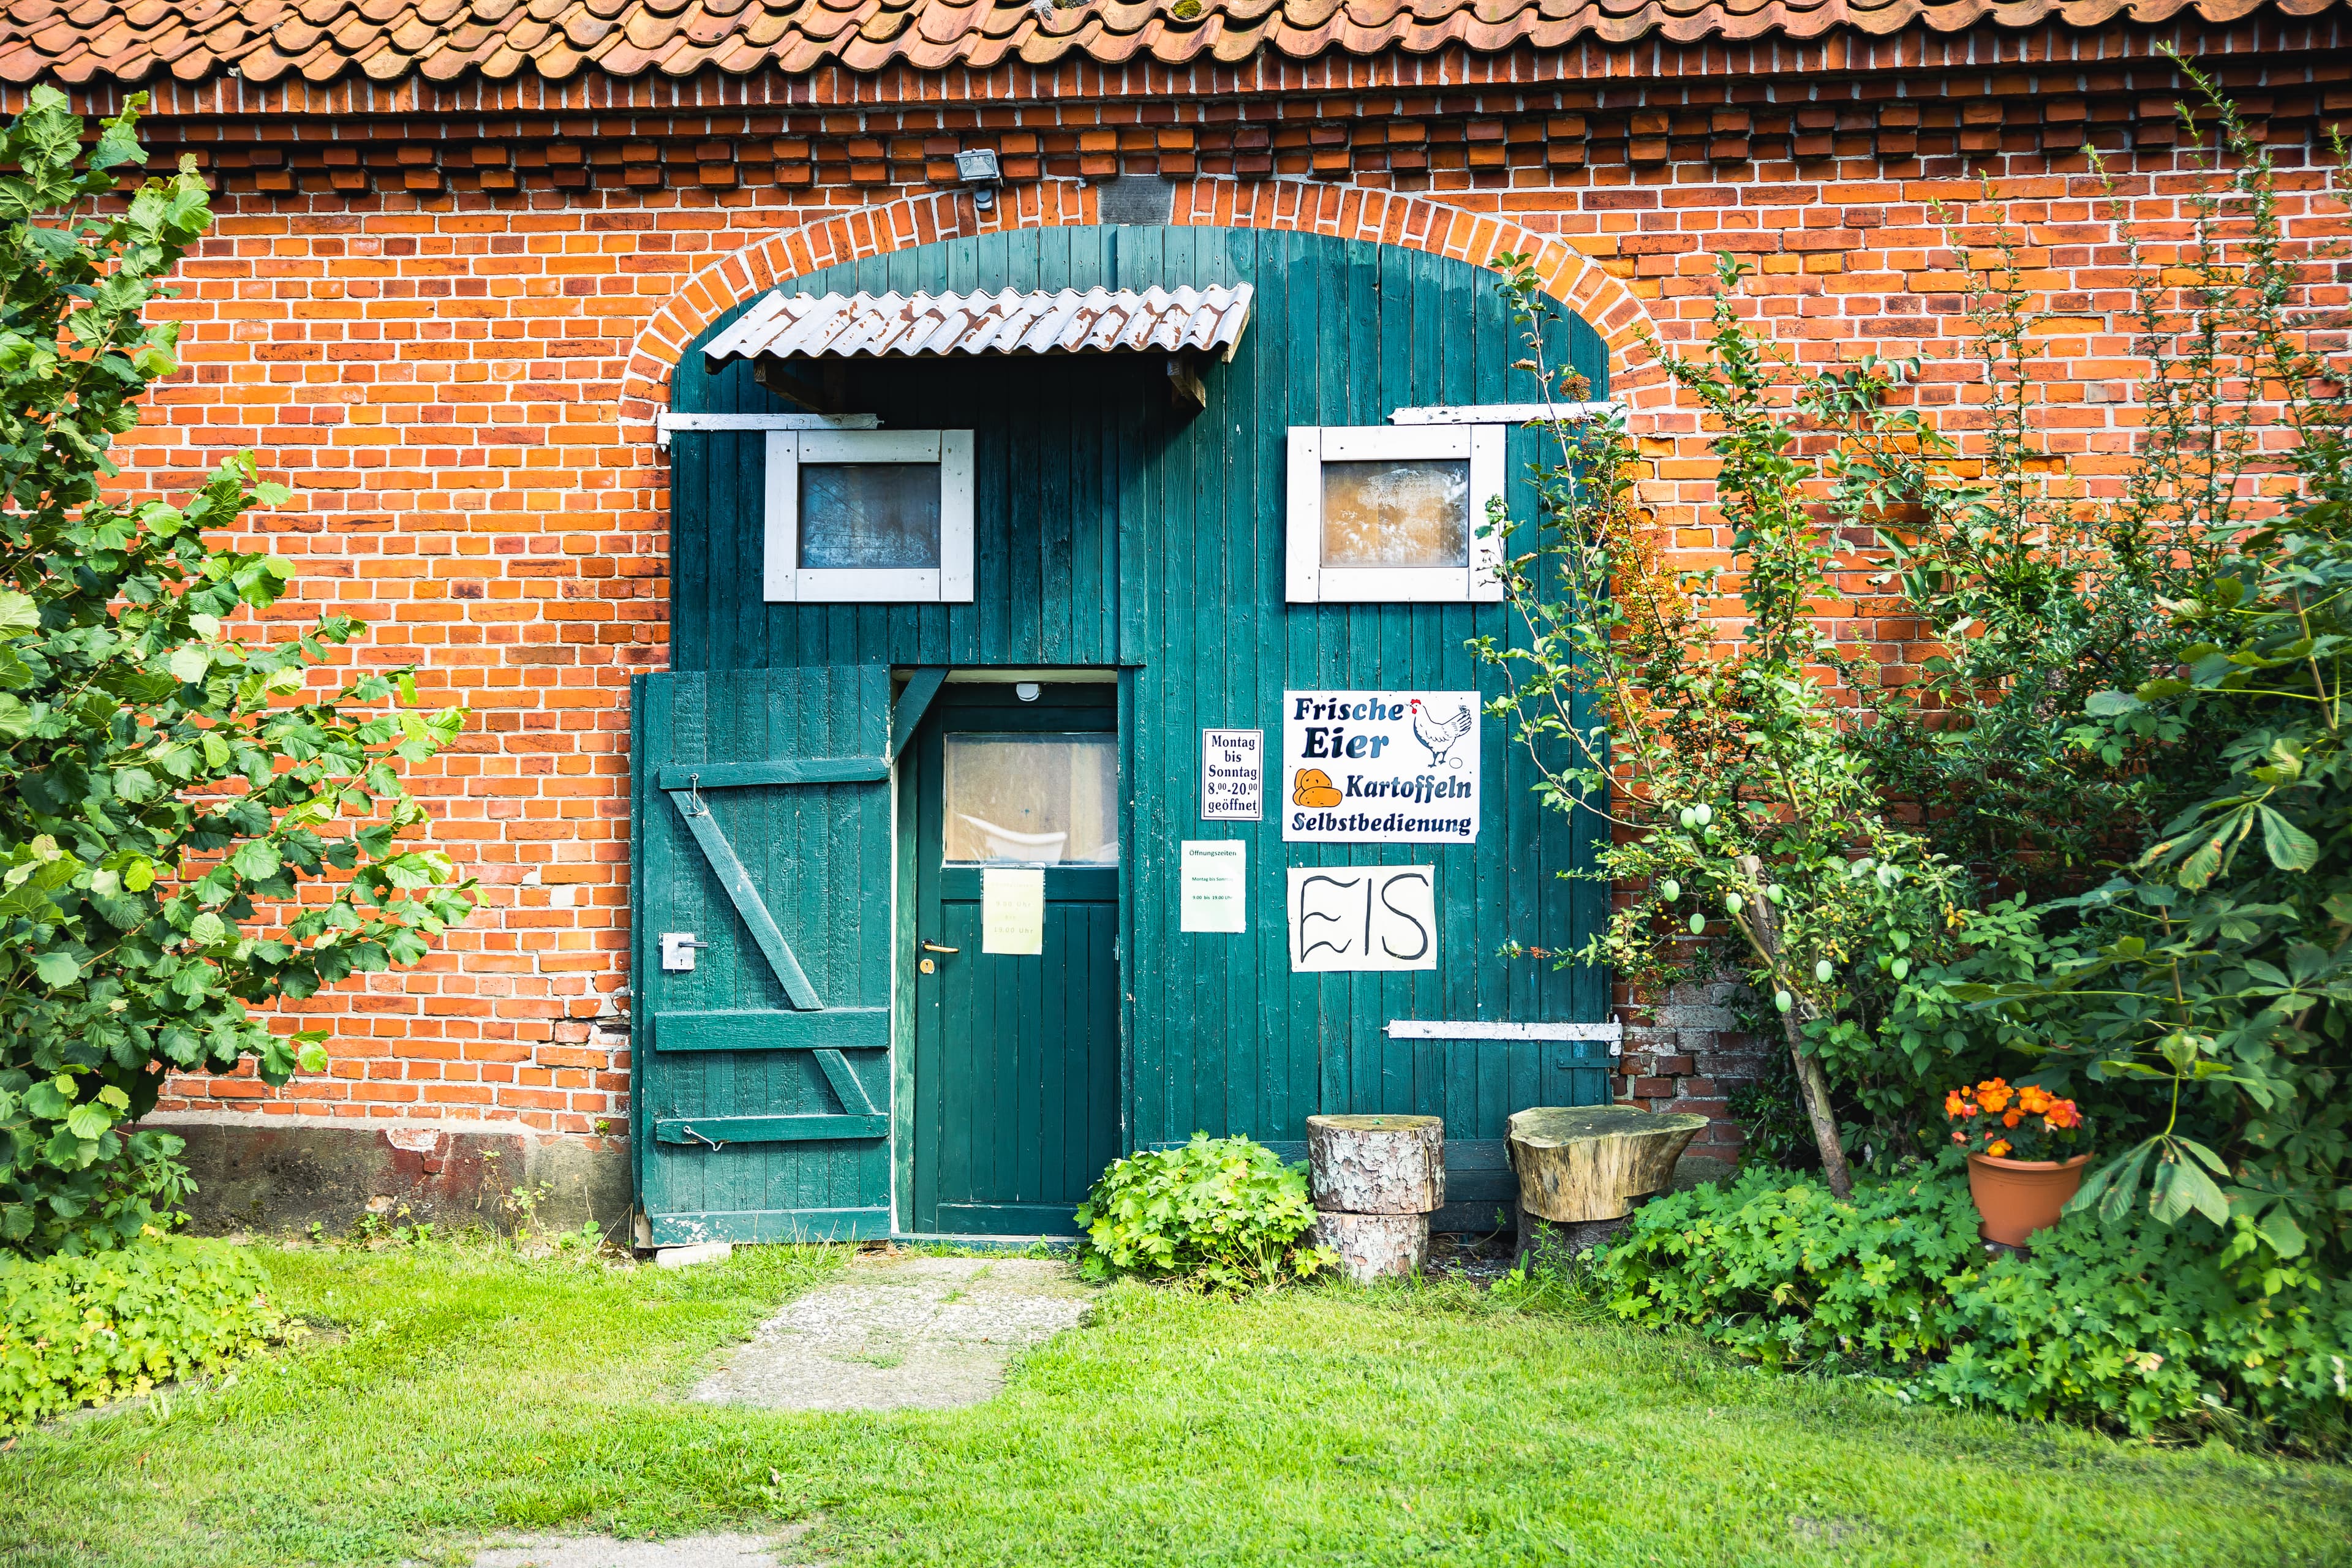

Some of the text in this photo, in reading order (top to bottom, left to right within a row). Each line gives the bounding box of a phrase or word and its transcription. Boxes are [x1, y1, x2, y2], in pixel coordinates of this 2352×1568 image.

[1294, 697, 1404, 721] Frische
[1212, 734, 1255, 750] Montag
[1301, 726, 1389, 759] Eier
[1224, 750, 1242, 763] bis
[1208, 764, 1257, 780] Sonntag
[1345, 775, 1471, 804] Kartoffeln
[1208, 797, 1257, 813] geöffnet
[1292, 812, 1471, 836] Selbstbedienung
[1300, 873, 1429, 963] EIS
